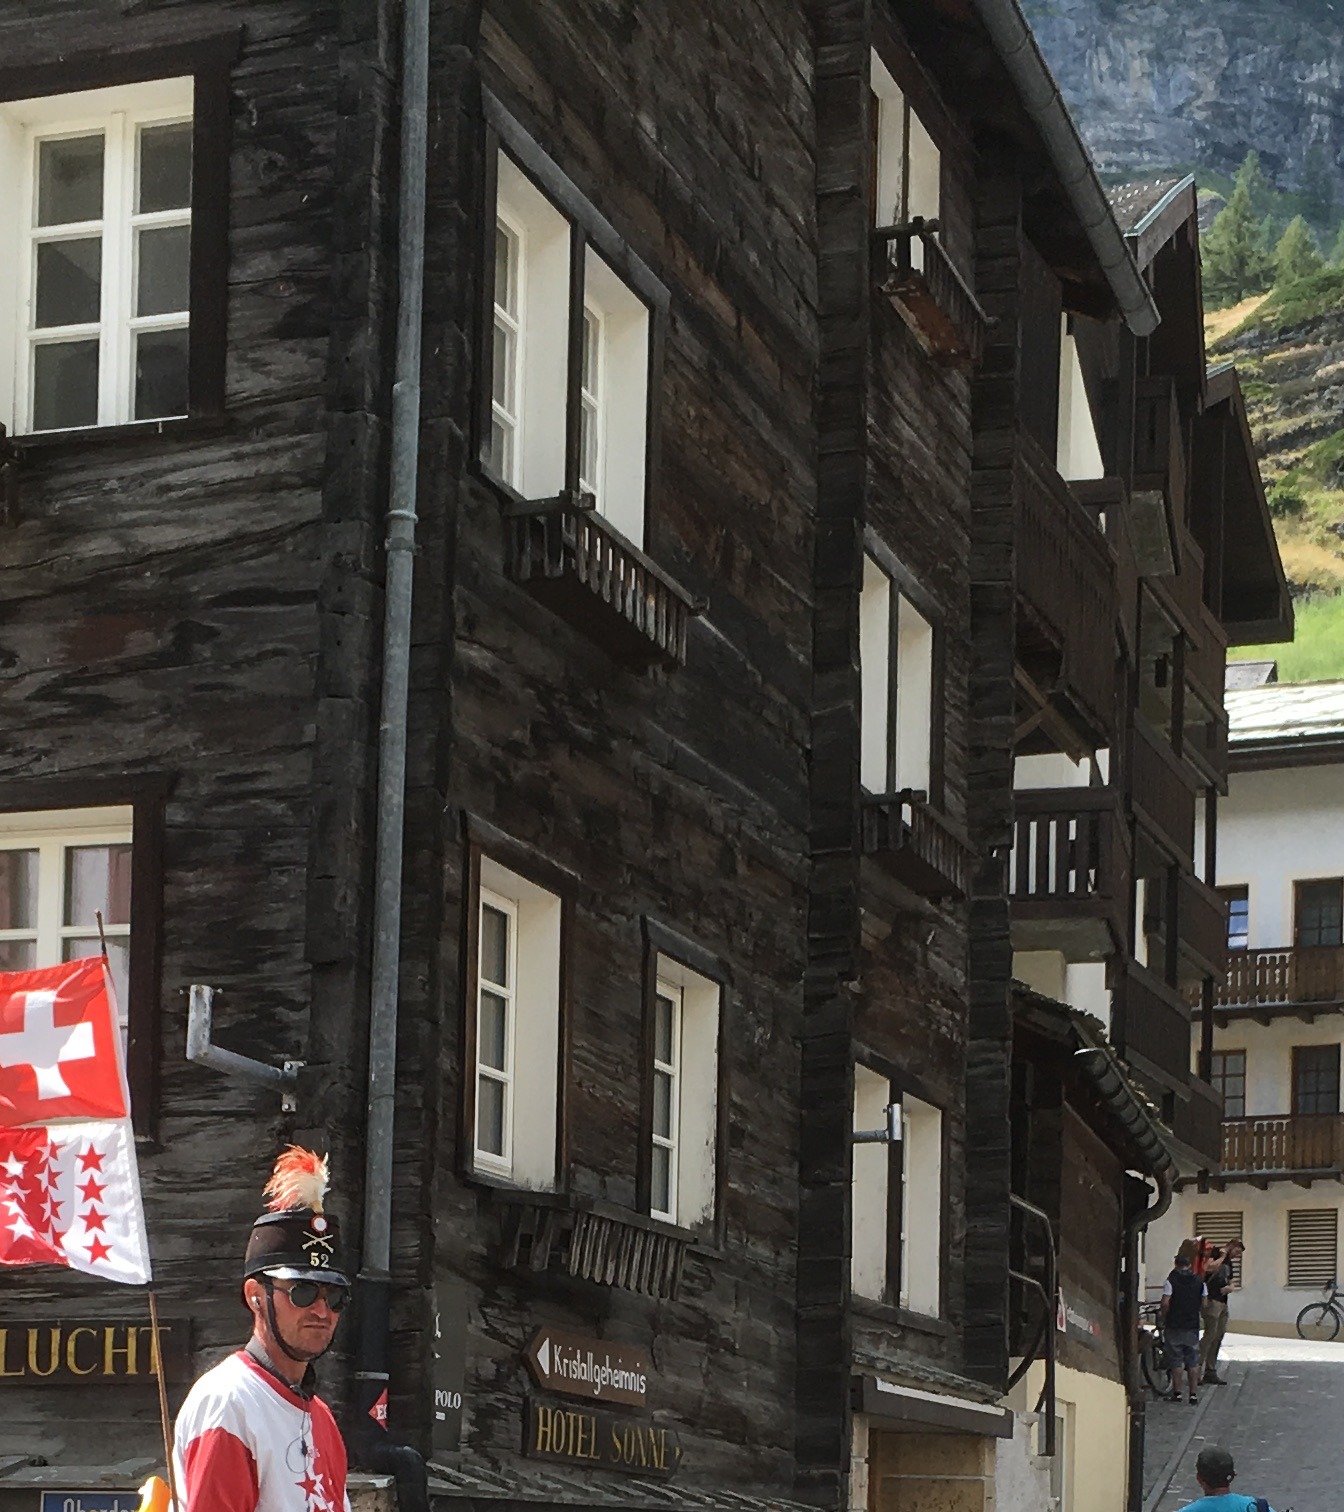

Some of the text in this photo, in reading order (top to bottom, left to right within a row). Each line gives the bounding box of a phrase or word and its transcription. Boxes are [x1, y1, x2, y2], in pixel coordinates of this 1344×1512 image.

[310, 1252, 329, 1268] 52
[553, 1344, 647, 1395] Kristallgeheimnis
[536, 1406, 671, 1471] HOTEL SONNE
